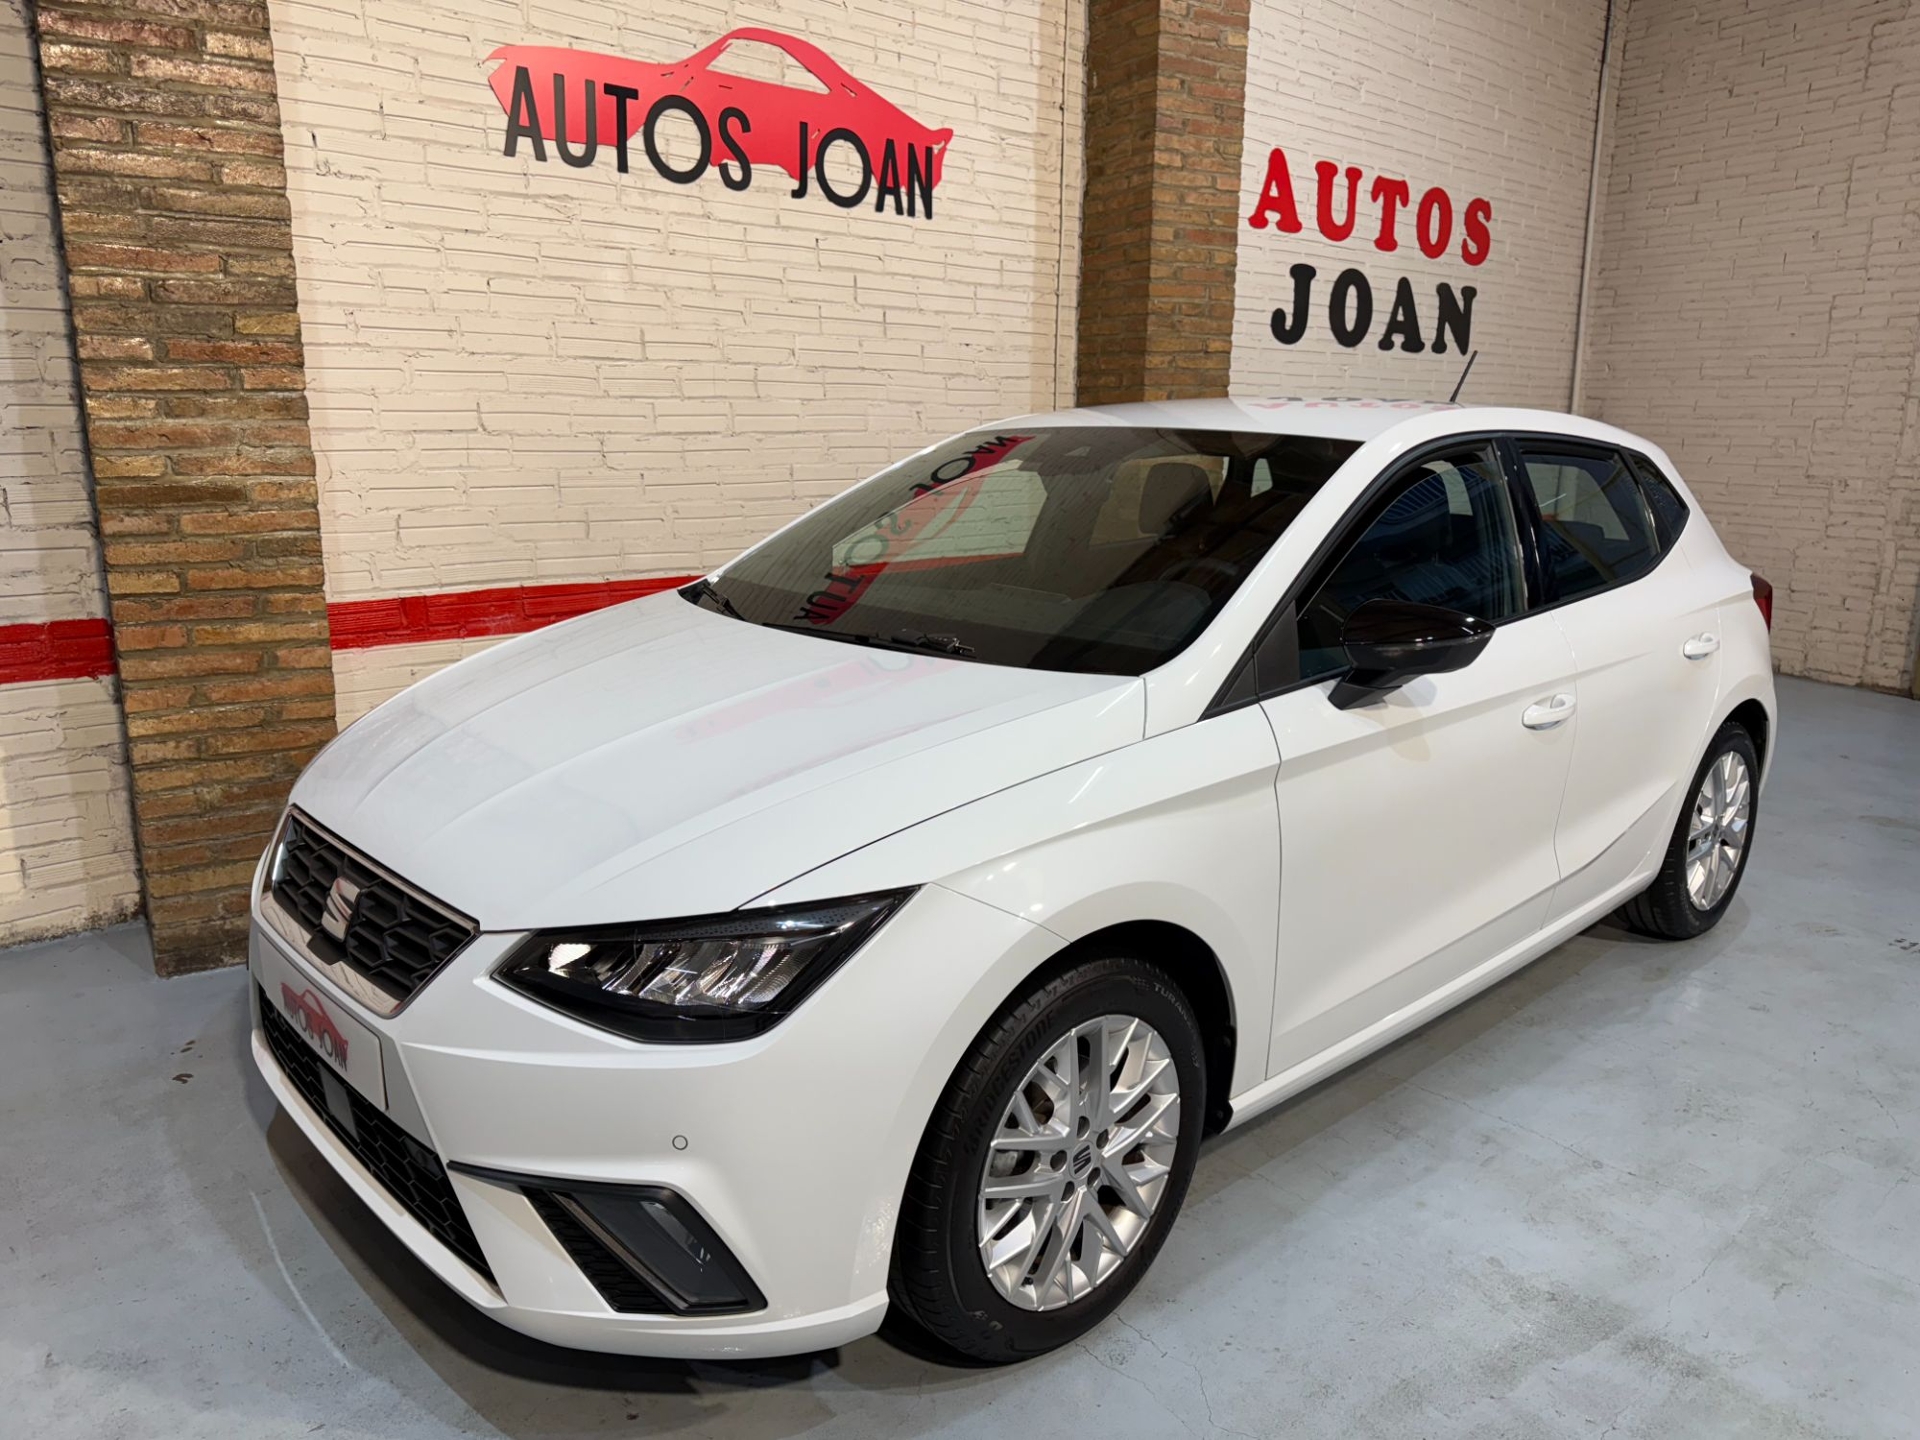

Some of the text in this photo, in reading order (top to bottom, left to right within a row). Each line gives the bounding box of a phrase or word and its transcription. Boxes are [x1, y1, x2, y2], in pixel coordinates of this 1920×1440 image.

[503, 65, 933, 220] AUTOS JOAN
[1248, 147, 1492, 266] AUTOS
[1270, 263, 1477, 356] JOAN
